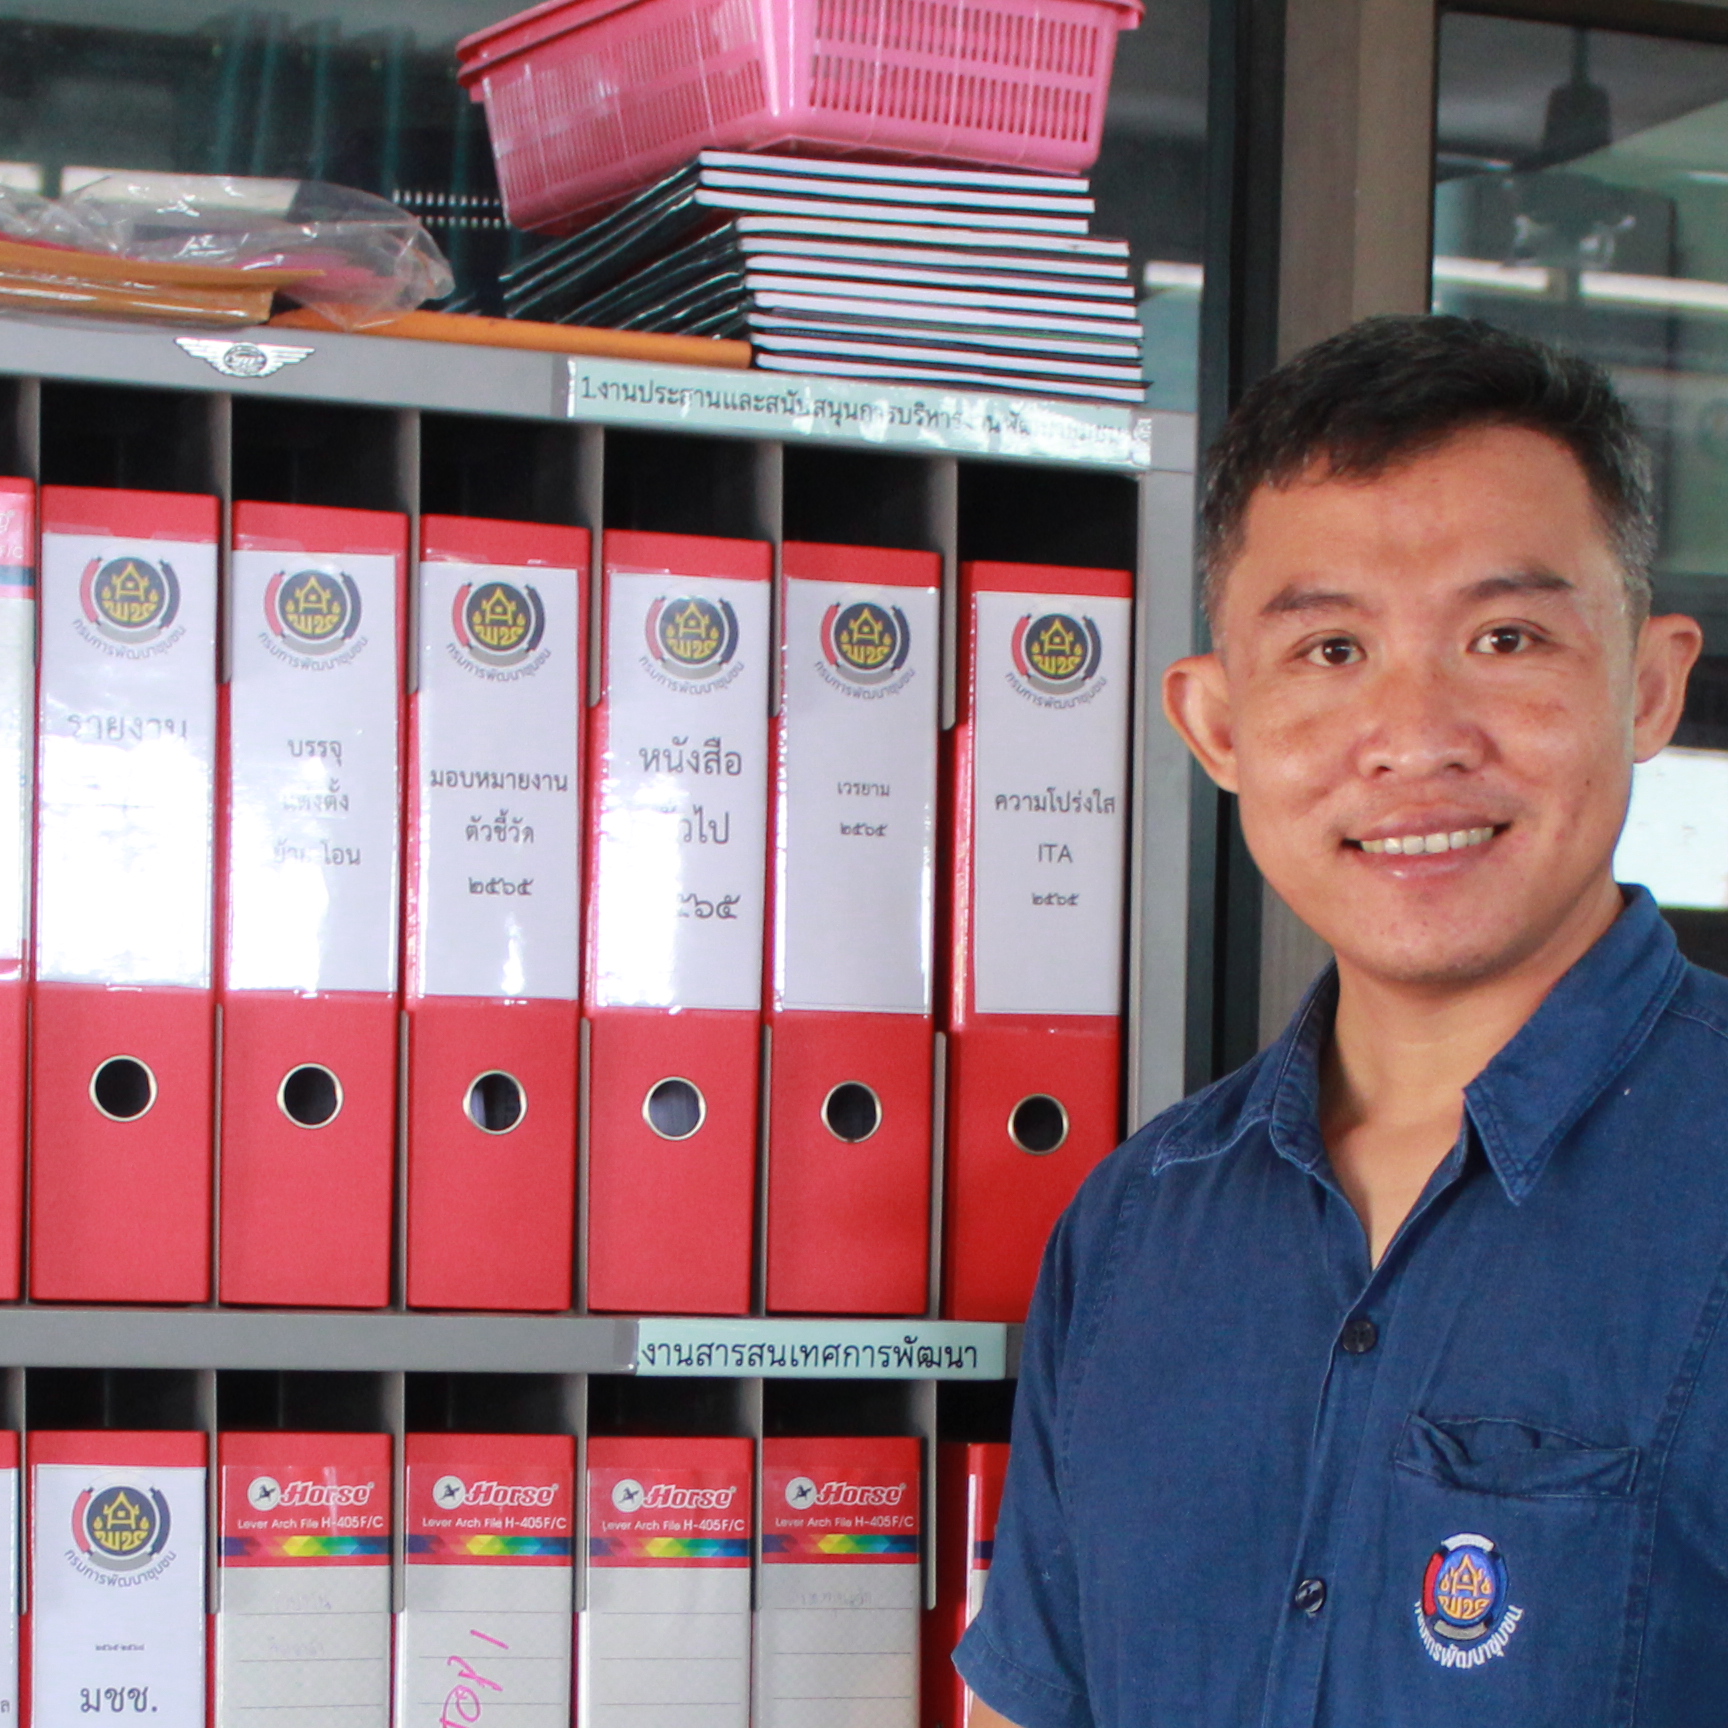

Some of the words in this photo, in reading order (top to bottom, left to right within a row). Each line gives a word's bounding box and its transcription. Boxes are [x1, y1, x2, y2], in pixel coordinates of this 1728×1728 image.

[72, 617, 186, 660] กรมการพัฒนาชุมชน
[258, 630, 369, 672] กรมการพัฒนาชุมชน
[446, 640, 552, 684] กรมการพัฒนาชุมชน
[638, 654, 745, 696] กรมการพัฒนาชุมชน
[814, 659, 916, 699] กรมการพัฒนาชุมชน
[1004, 671, 1108, 710] กรมการพัฒนาชุมชน
[288, 737, 343, 768] บรรจุ
[639, 738, 743, 777] หนังสือ
[430, 768, 569, 794] มอบหมายงาน
[837, 780, 890, 799] เวรยาม
[995, 787, 1116, 815] ความโปร่งใส
[465, 809, 535, 845] ตัวชี้วัด
[322, 841, 362, 867] โอน
[1038, 843, 1072, 864] ITA
[468, 877, 534, 896] ๒๕๖๕
[641, 1335, 978, 1369] งานสารสนเทศการพัฒนา
[279, 1480, 371, 1508] Horse
[465, 1481, 555, 1507] Horse
[643, 1485, 733, 1509] Horse
[816, 1481, 902, 1505] Horse
[237, 1517, 268, 1532] Lever
[271, 1517, 297, 1530] Arch
[299, 1517, 319, 1530] File
[321, 1515, 384, 1531] H-405F/C
[422, 1517, 453, 1529] Lever
[455, 1516, 481, 1528] Arch
[483, 1516, 503, 1528] File
[504, 1516, 567, 1530] H-405F/C
[602, 1520, 632, 1532] Lever
[634, 1520, 660, 1531] Arch
[662, 1520, 681, 1531] File
[683, 1519, 745, 1533] H-405F/C
[775, 1517, 804, 1528] Lever
[806, 1516, 831, 1527] Arch
[833, 1516, 852, 1527] File
[854, 1516, 914, 1529] H-405F/C
[65, 1549, 177, 1588] กรมการพัฒนาชุมชน
[80, 1686, 158, 1714] มชช.
